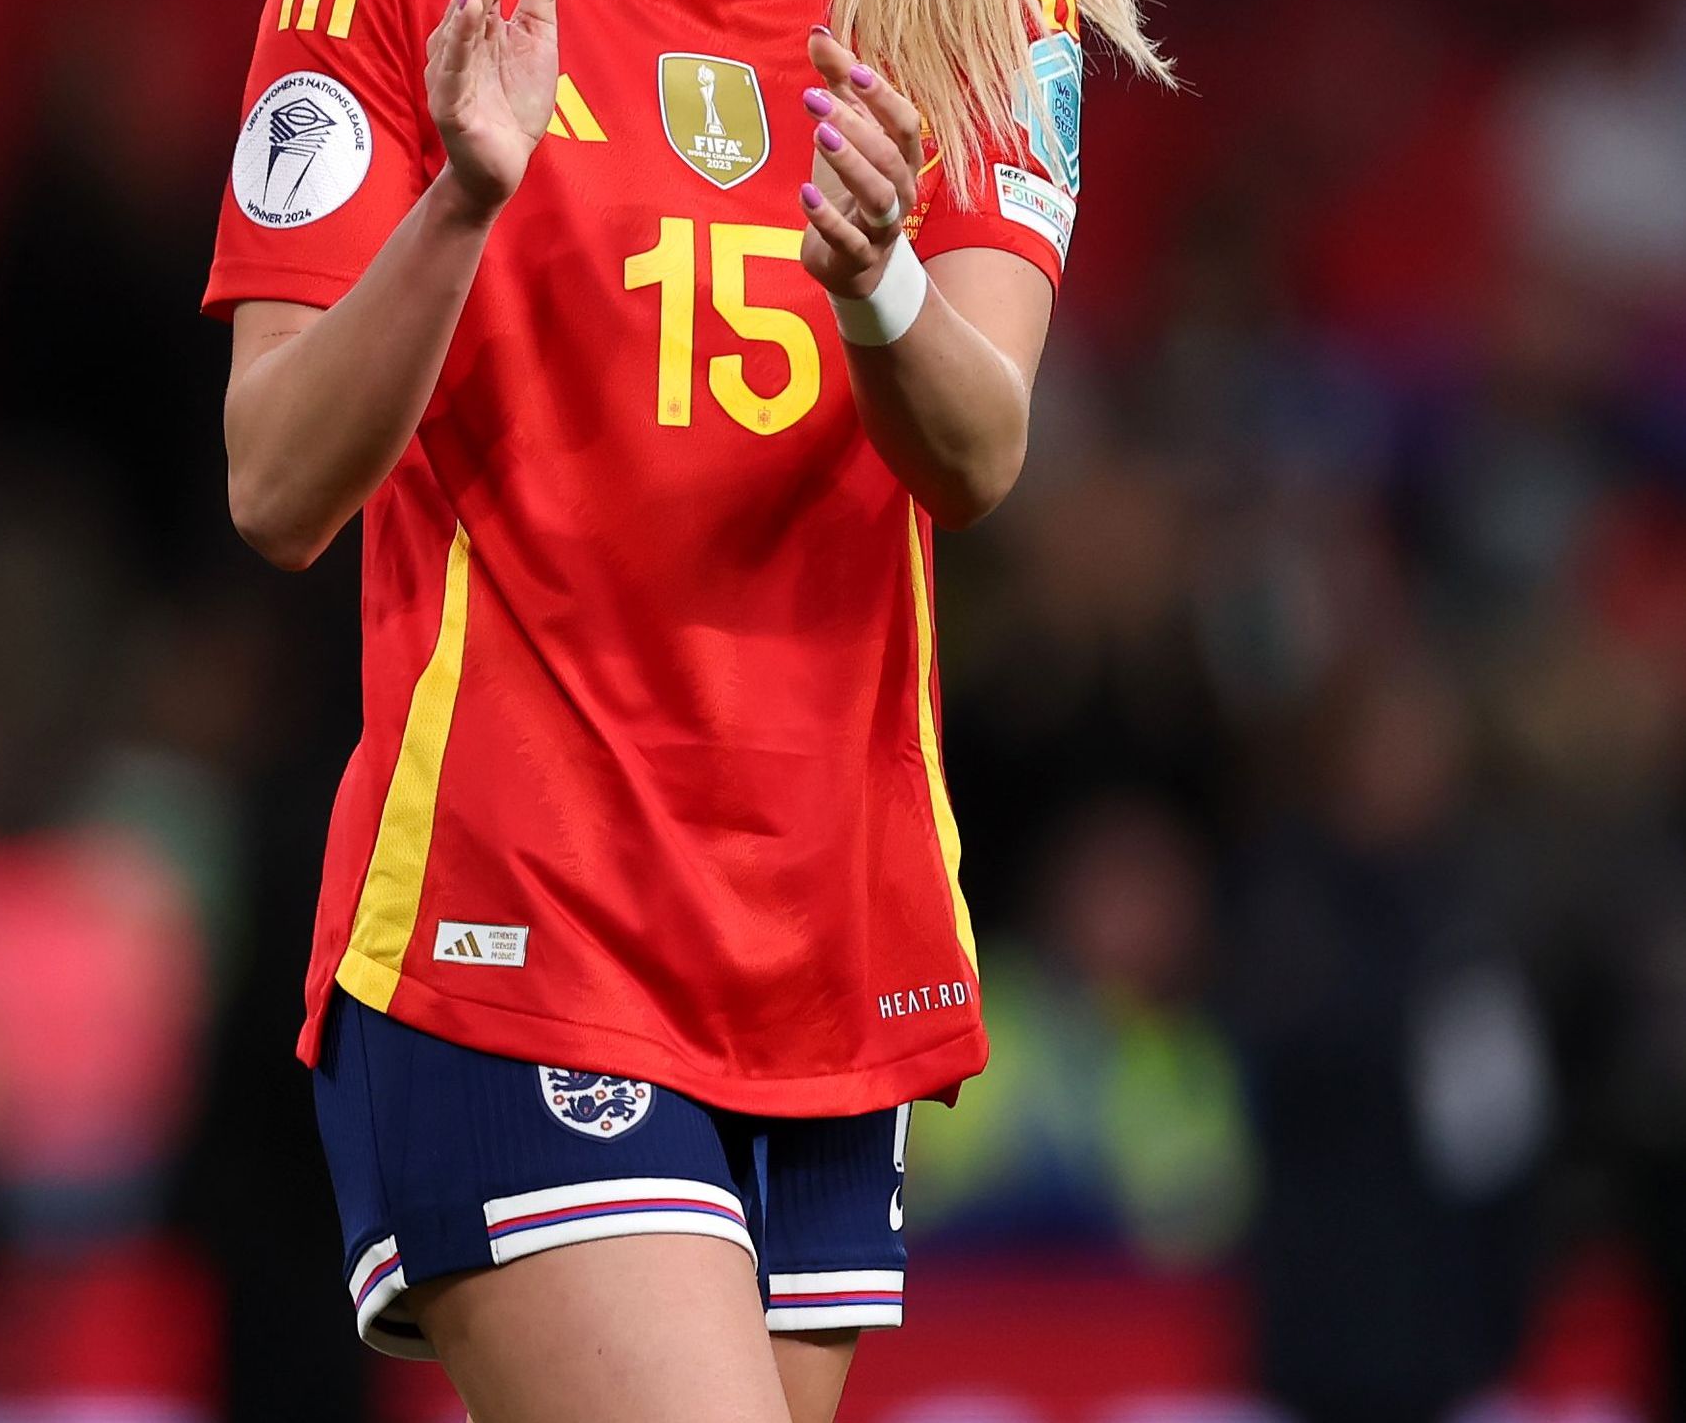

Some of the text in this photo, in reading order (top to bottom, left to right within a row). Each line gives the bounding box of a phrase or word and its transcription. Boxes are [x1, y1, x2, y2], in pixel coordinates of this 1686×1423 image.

[1053, 79, 1071, 101] We
[246, 77, 365, 151] UEFA WOMEN'S NATIONS LEAGUE
[706, 158, 732, 171] 2023
[999, 167, 1027, 184] UEFA
[246, 199, 312, 224] WINNER 2024
[624, 216, 821, 436] 15
